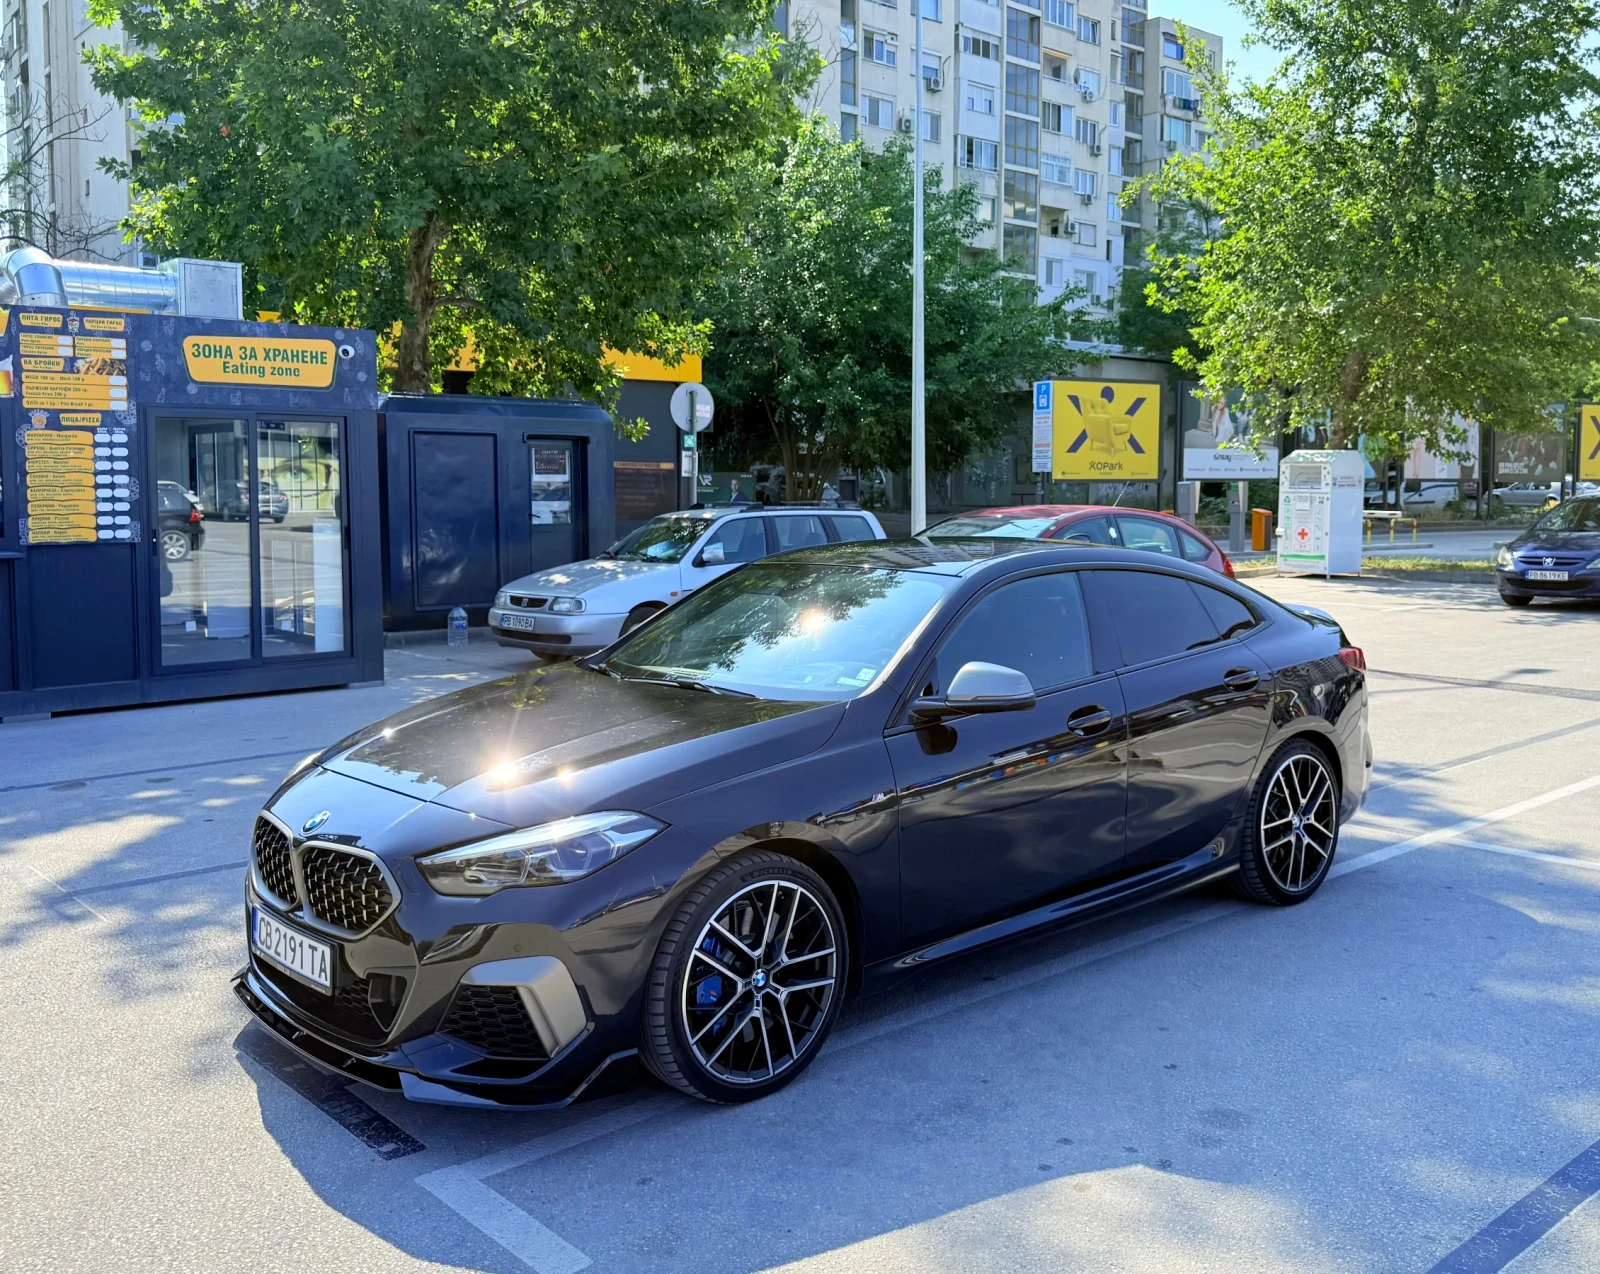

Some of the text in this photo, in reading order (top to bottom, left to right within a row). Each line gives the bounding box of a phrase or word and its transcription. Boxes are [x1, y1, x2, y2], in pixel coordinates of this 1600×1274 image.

[192, 343, 328, 365] ЗОНА ЗА ХРАНЕНЕ
[223, 361, 300, 378] Eating zone
[1042, 385, 1046, 393] P
[1214, 453, 1232, 463] sinsay
[259, 916, 272, 950] CB
[274, 927, 303, 970] 2191
[308, 944, 328, 981] TA
